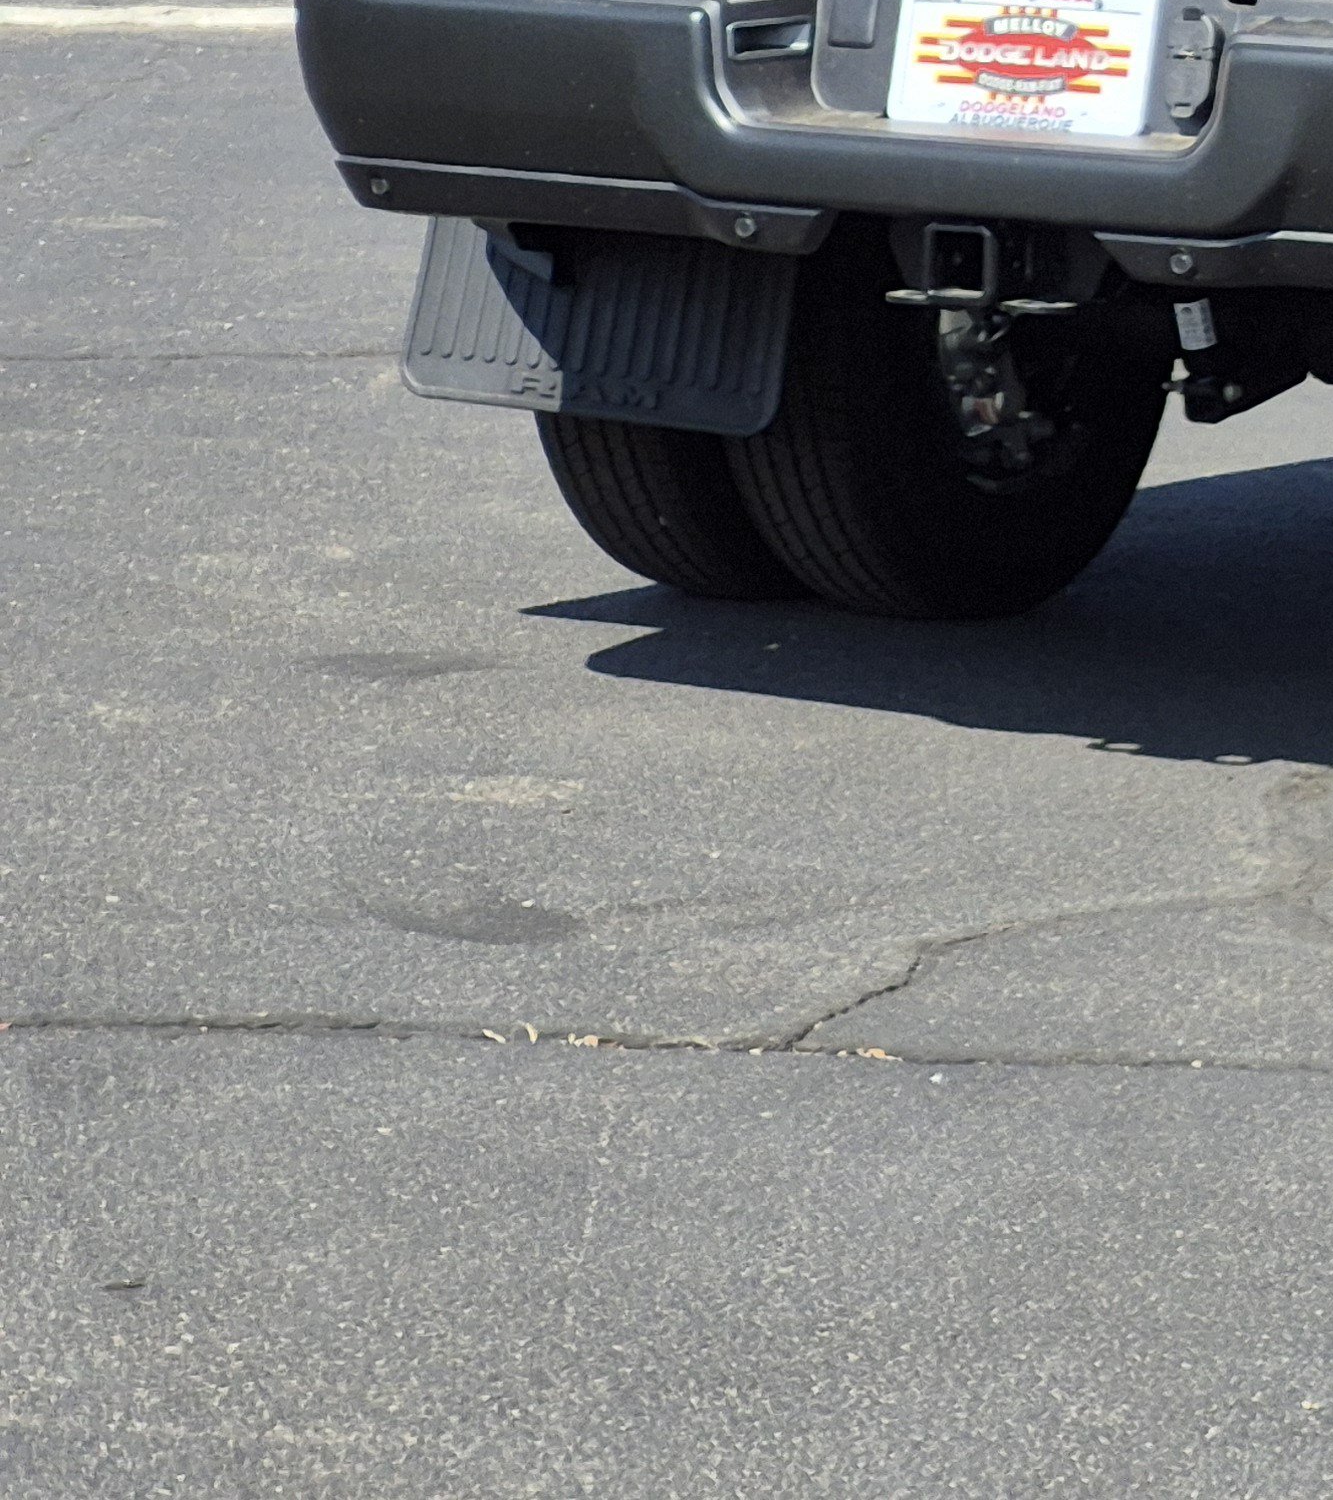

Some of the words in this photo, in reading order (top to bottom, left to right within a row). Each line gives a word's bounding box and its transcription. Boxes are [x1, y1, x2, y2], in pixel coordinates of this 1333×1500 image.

[992, 16, 1069, 37] MELLOY
[936, 40, 1032, 66] DODGE
[1033, 44, 1111, 71] LAND
[949, 112, 1074, 132] ALBUQUERQUE
